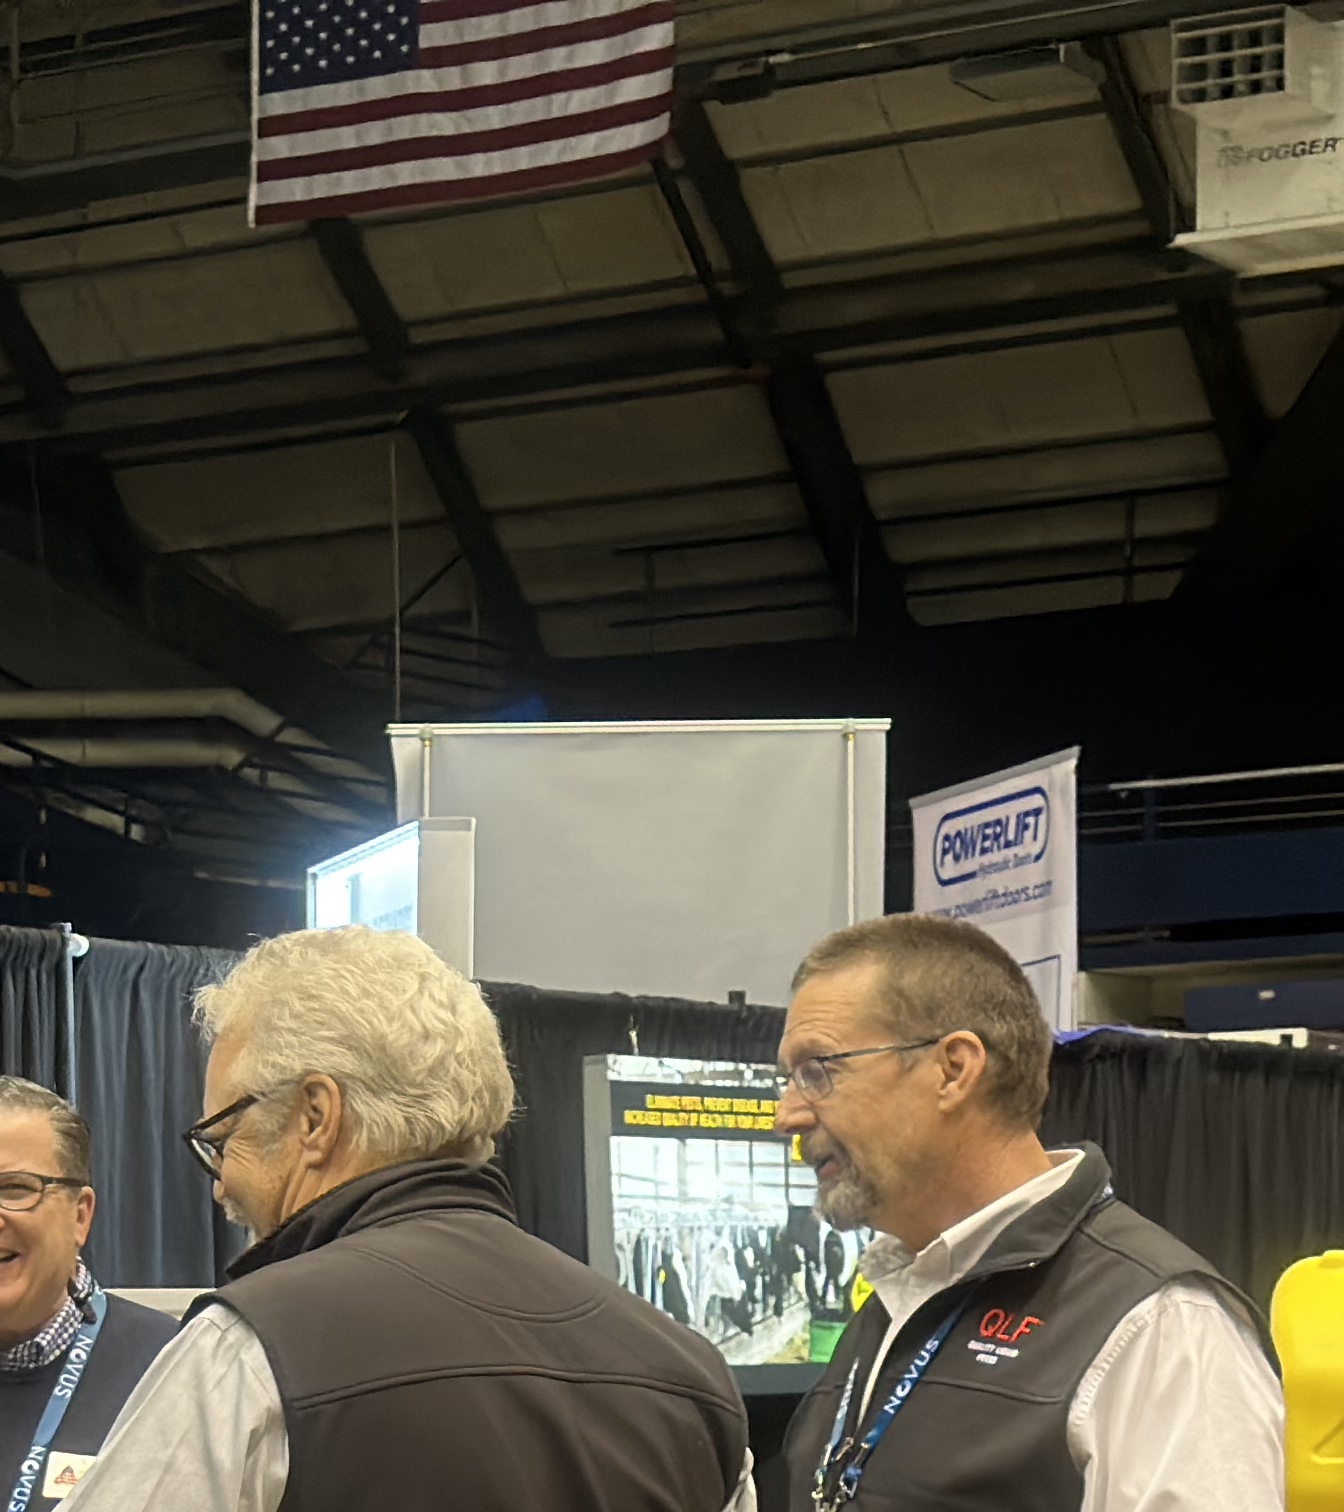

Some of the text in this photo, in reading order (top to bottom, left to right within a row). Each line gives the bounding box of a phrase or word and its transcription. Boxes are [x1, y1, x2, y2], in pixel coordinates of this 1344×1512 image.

[940, 806, 1045, 869] POWERLIFT
[979, 1308, 1045, 1341] QLF
[54, 1335, 93, 1399] NOVUS
[884, 1338, 940, 1415] NOVUS
[8, 1445, 47, 1512] NOVUS
